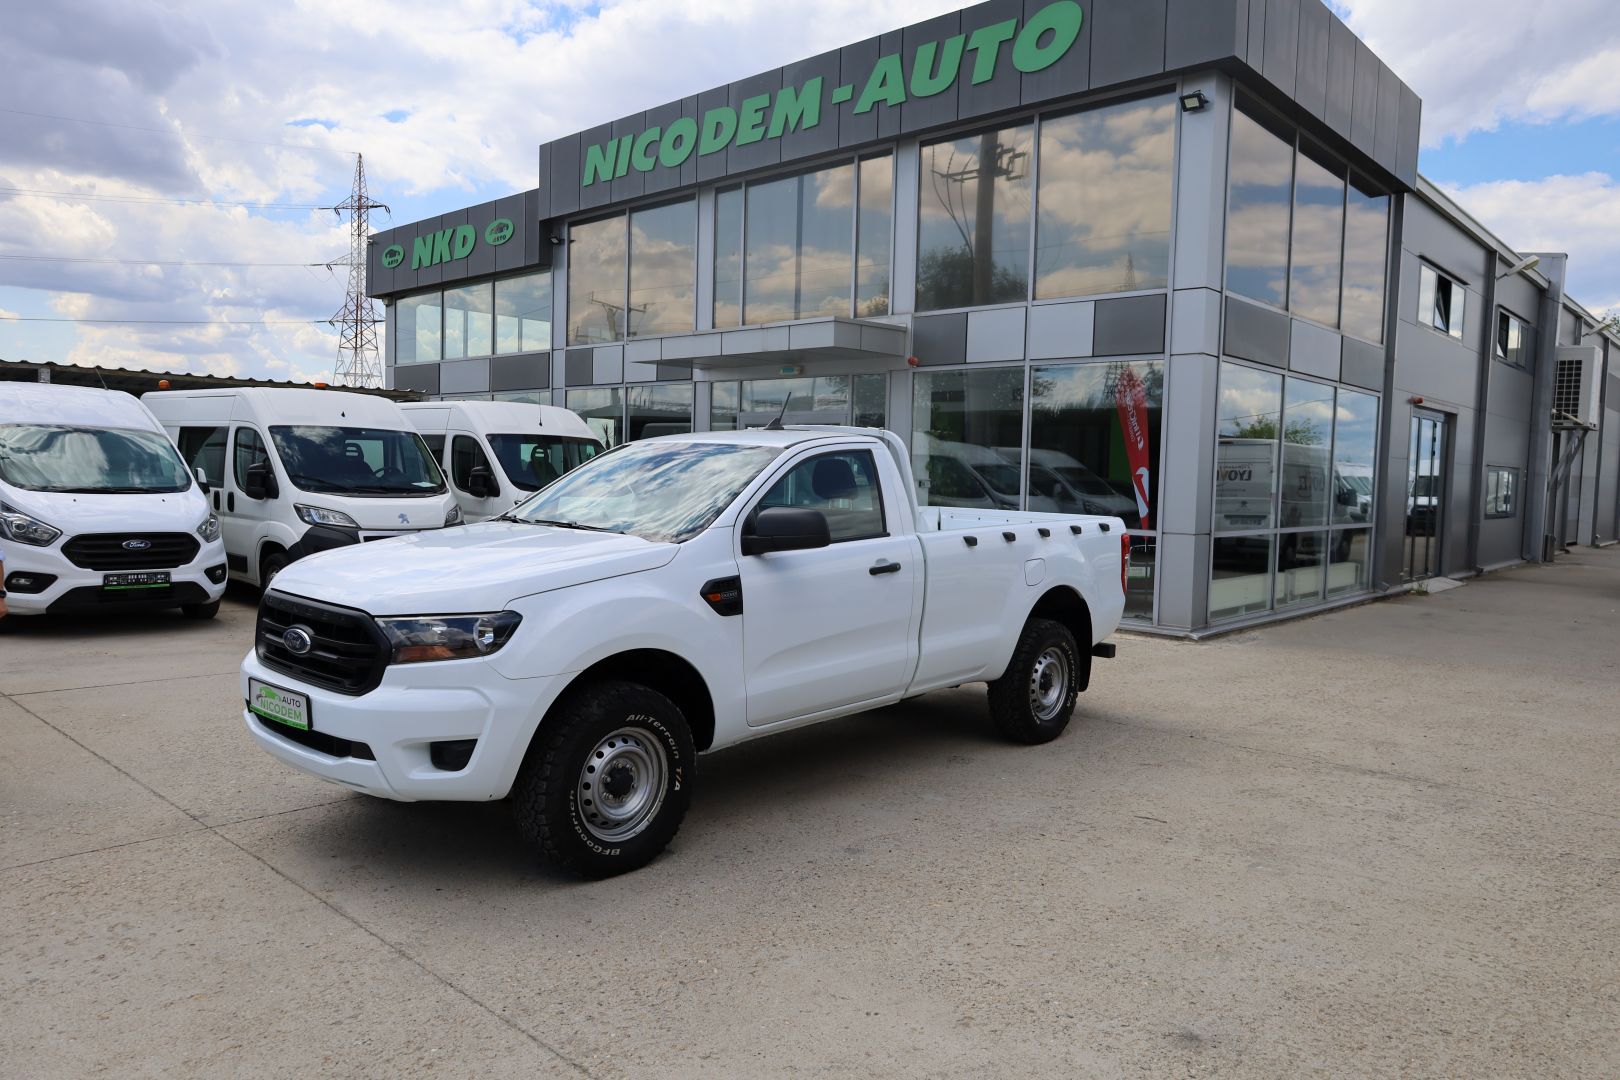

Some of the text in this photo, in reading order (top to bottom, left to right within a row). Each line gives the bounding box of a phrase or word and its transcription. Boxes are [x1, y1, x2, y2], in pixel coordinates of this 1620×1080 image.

[411, 224, 476, 270] NKD
[260, 698, 302, 721] NICODEM
[282, 696, 301, 708] AUTO
[626, 714, 680, 759] All-Terrain
[569, 790, 621, 856] BFGoodrich
